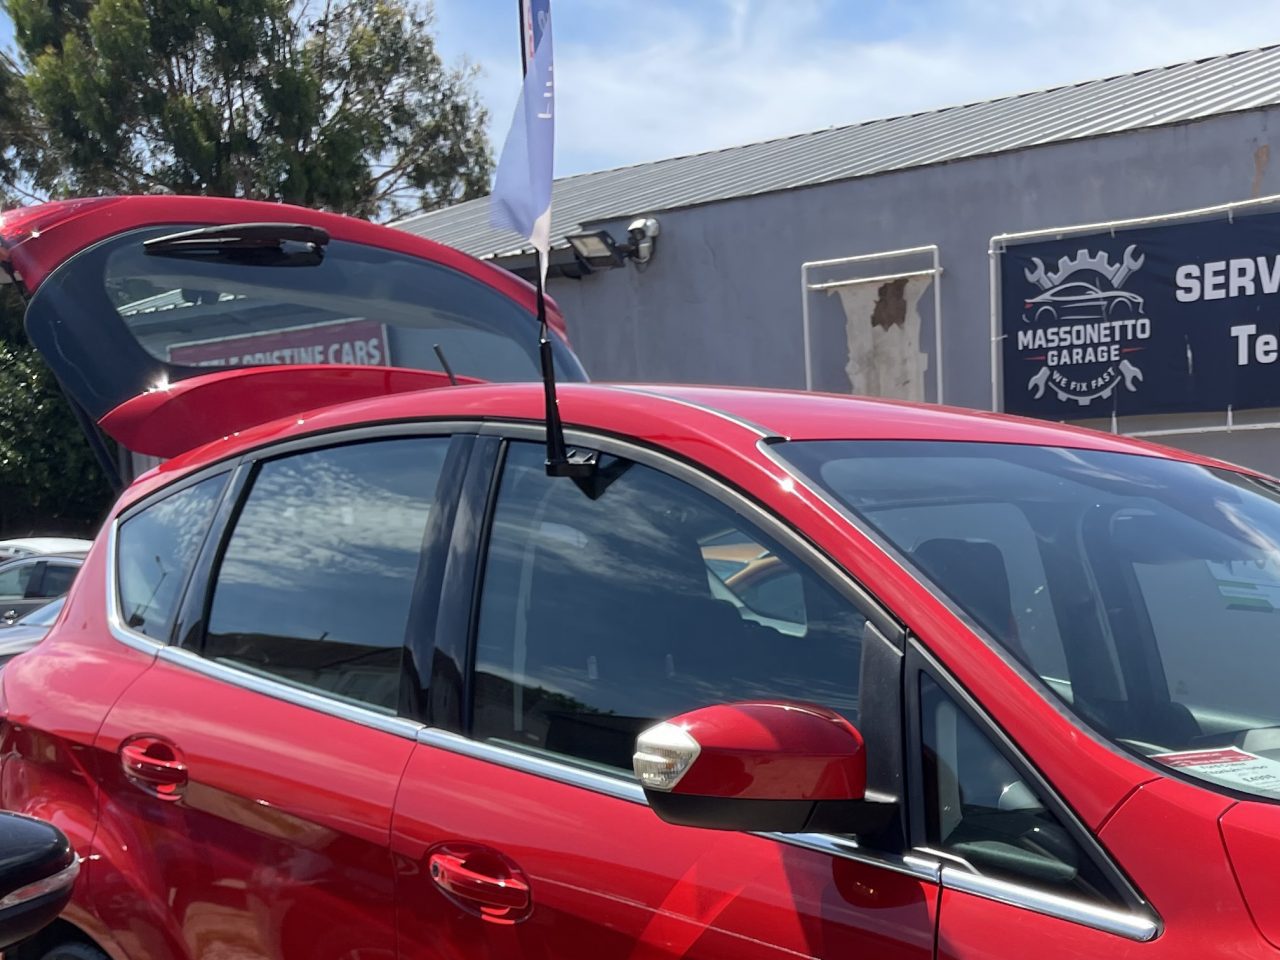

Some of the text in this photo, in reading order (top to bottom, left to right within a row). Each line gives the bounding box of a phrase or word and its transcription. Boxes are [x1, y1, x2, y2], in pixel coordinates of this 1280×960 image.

[1017, 318, 1151, 351] MASSONETTO
[328, 338, 380, 366] CARS
[1047, 344, 1120, 367] GARAGE
[1052, 366, 1115, 392] WE FIX FAST
